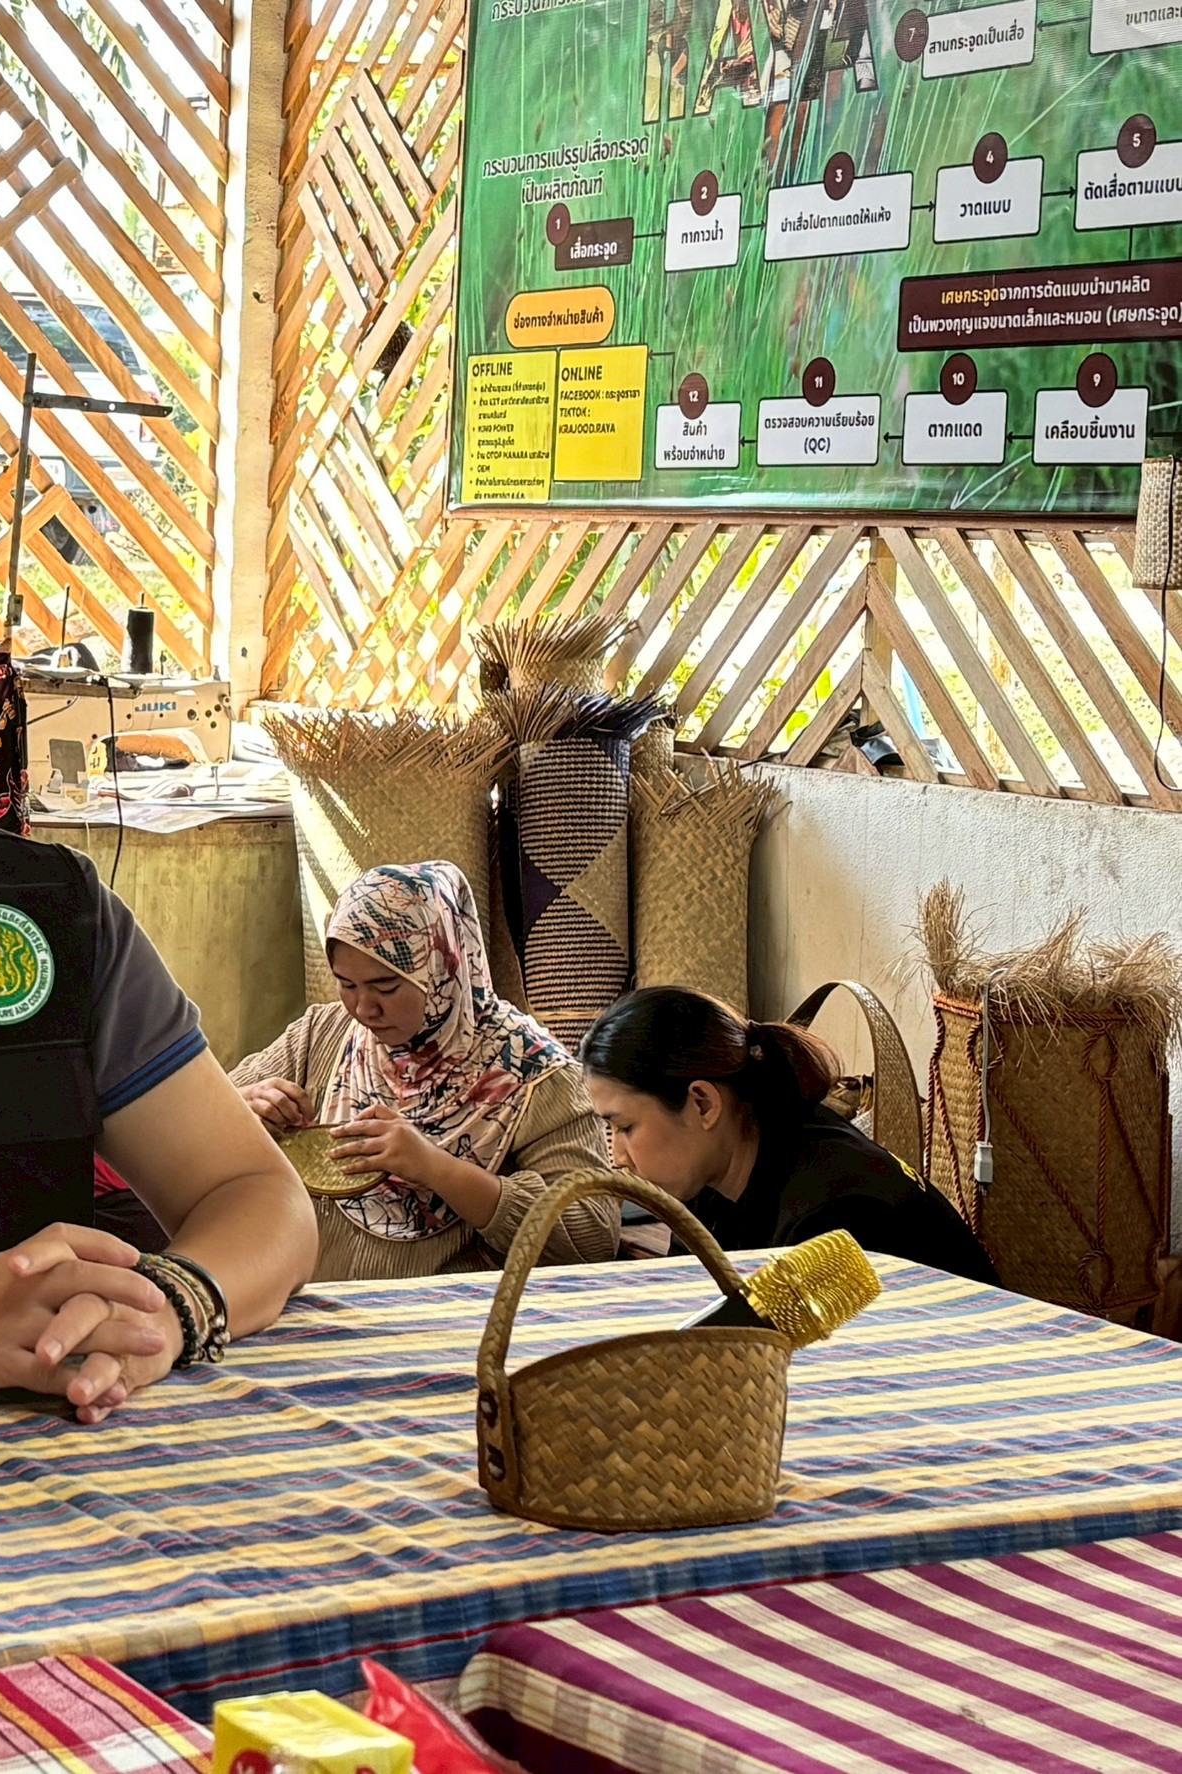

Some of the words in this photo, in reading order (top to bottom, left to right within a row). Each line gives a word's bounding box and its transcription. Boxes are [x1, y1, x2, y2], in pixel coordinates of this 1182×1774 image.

[908, 28, 916, 42] 7
[929, 19, 1025, 54] สานกระจูดเป็นเสื่อ
[1132, 133, 1141, 147] 5
[483, 129, 650, 178] กระบวนการแปรรูปเสื่อกระจูด
[986, 151, 994, 164] 4
[835, 169, 843, 182] 3
[522, 170, 604, 205] เป็นผลิตภัณฑ์
[701, 186, 708, 198] 2
[960, 199, 1011, 217] วาดแบบ
[555, 218, 561, 229] 1
[781, 206, 891, 232] นำเสื่อไปตากแดดให้แห้ง
[570, 237, 618, 261] เสื่อกระจูด
[941, 276, 1150, 307] เศษกระจูดจากการตัดแบบนำมาผลิต
[514, 306, 604, 329] ช่องทางจำหน่ายสินค้า
[909, 308, 1101, 335] เป็นพวงกุญแจขนาดเล็กและหมอน
[472, 362, 513, 377] OFFLINE
[561, 365, 603, 381] ONLINE
[814, 376, 823, 388] 11
[952, 372, 964, 386] 10
[1093, 374, 1101, 387] 9
[688, 391, 699, 402] 12
[682, 419, 707, 437] สินค้า
[764, 411, 875, 430] ตรวจสอบความเรียบร้อย
[1045, 415, 1135, 440] เคลือบชิ้นงาน
[928, 421, 983, 438] ตากแดด
[664, 444, 725, 461] พร้อมจำหน่าย
[804, 437, 831, 454] (QC)
[135, 701, 177, 712] JUKI
[14, 1003, 30, 1016] AND
